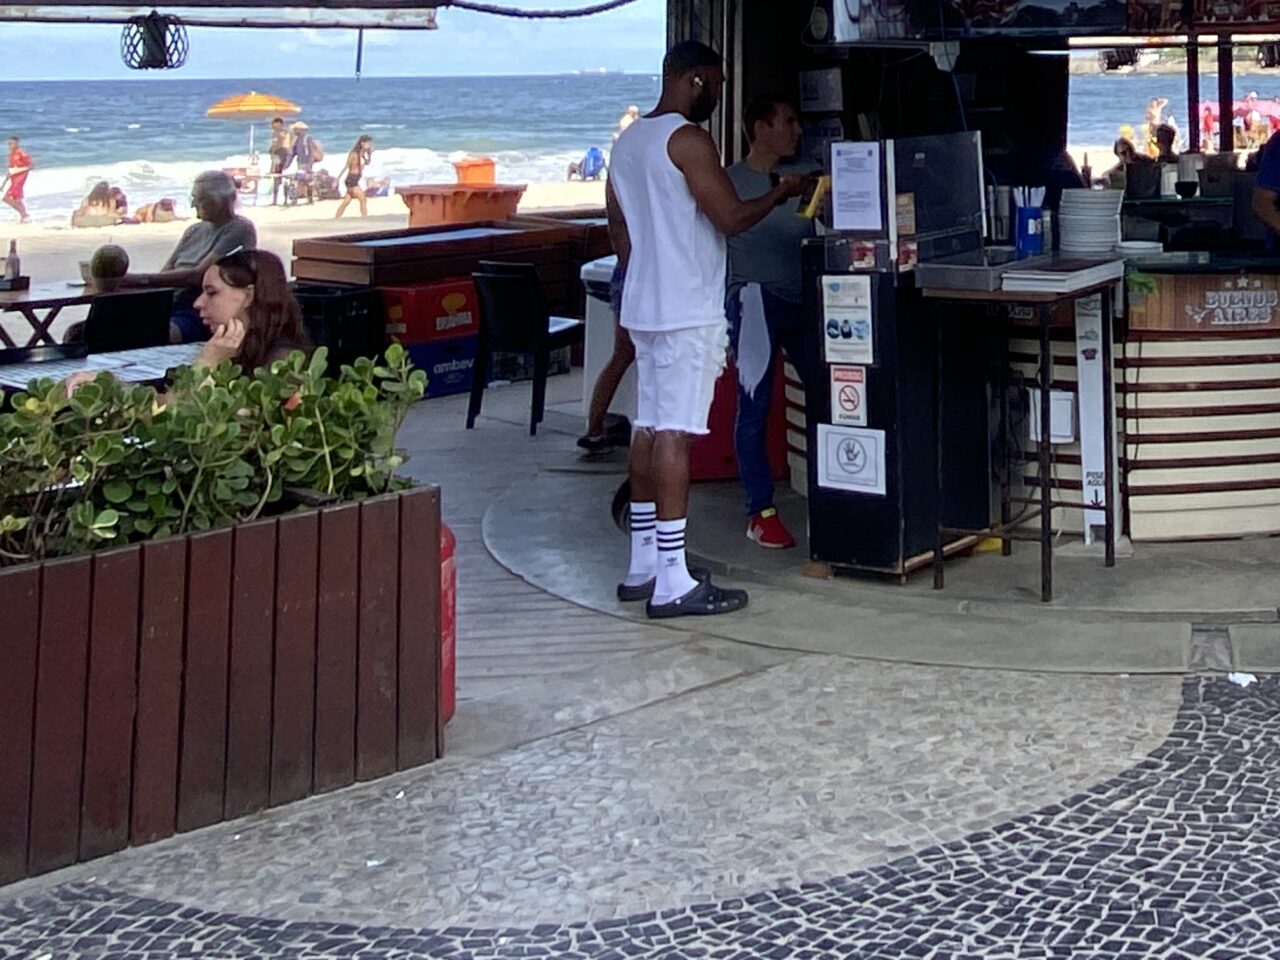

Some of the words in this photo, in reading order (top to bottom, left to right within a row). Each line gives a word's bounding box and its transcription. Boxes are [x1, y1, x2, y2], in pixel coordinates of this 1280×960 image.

[1205, 291, 1277, 308] BUENOS
[1211, 307, 1272, 325] AIRES
[433, 358, 475, 374] ambev
